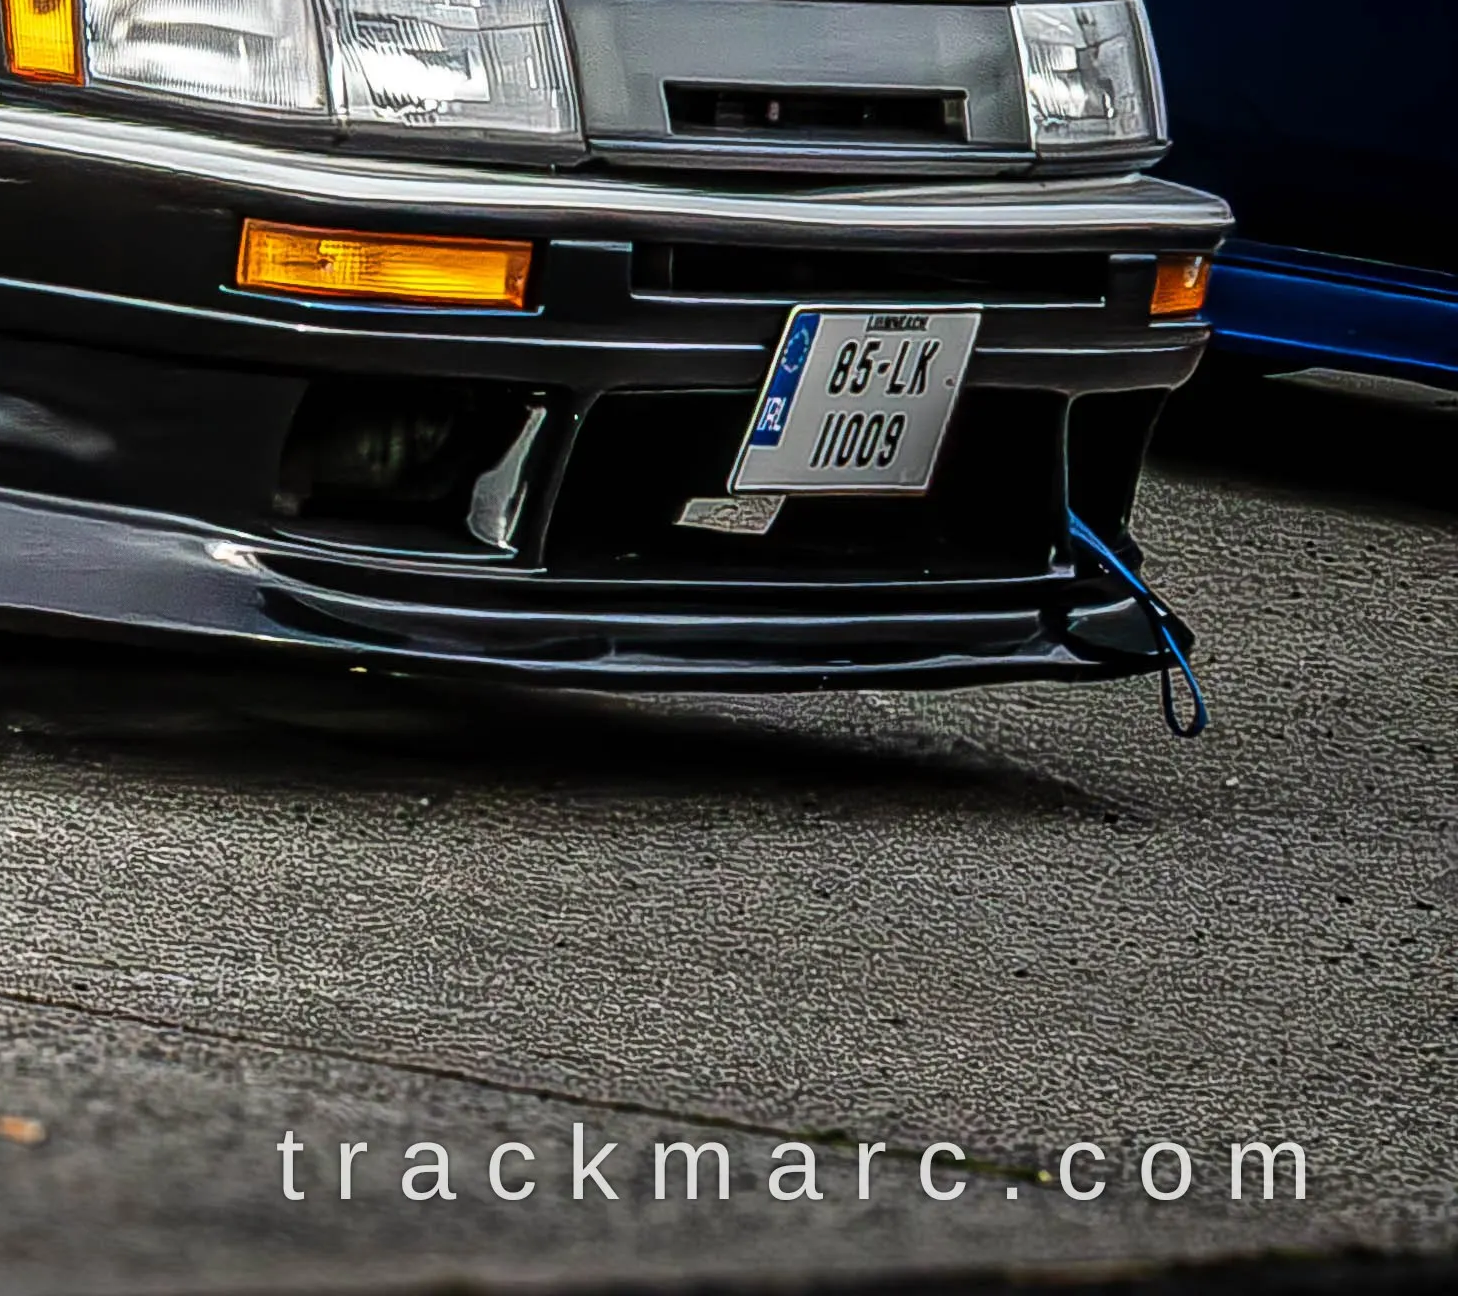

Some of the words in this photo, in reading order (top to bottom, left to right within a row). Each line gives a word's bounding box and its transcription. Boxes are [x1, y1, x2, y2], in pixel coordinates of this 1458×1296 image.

[827, 340, 940, 395] 85-LK
[757, 396, 786, 431] IRL
[809, 412, 907, 469] 11009
